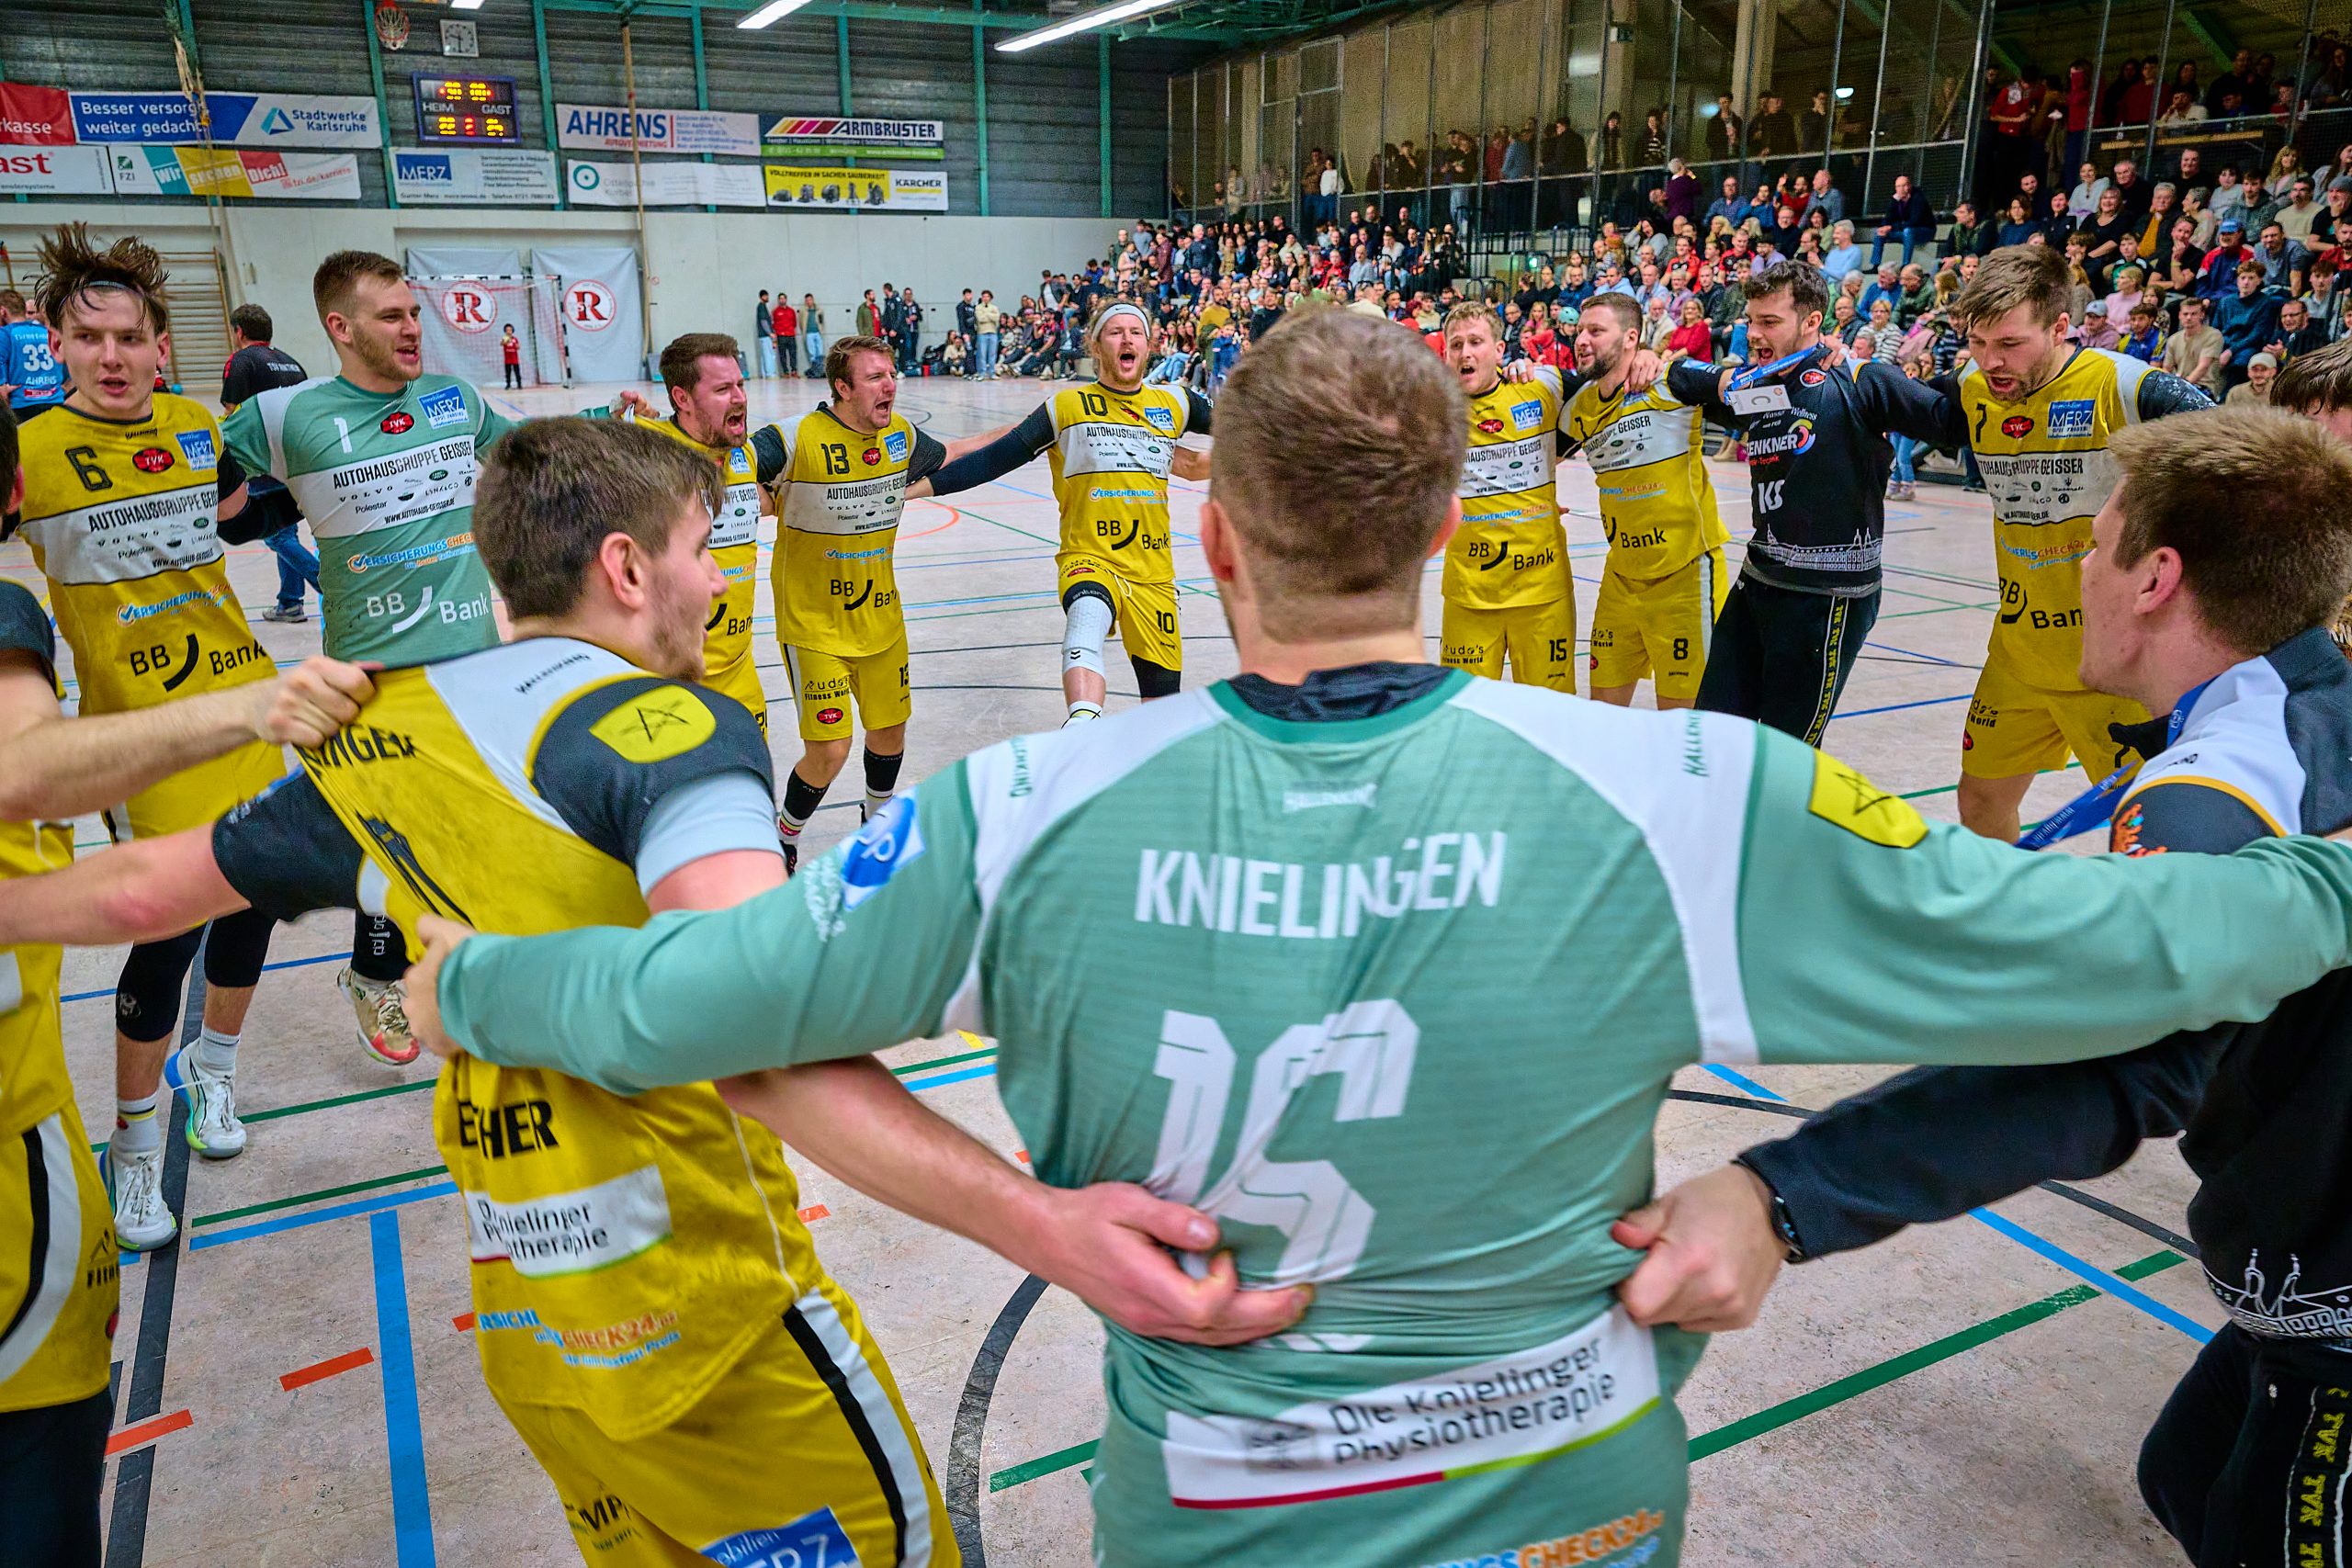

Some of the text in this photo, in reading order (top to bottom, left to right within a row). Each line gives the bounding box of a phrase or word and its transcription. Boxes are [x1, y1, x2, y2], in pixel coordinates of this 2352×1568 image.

[81, 101, 135, 115] Besser
[292, 109, 367, 122] Stadtwerke
[422, 102, 513, 116] HEIM GAST
[85, 119, 137, 134] weiter
[307, 120, 368, 132] Karlsruhe
[566, 109, 666, 139] AHRENS
[831, 120, 936, 138] ARMBRUSTER
[119, 172, 135, 181] FZI
[154, 166, 182, 184] Wir
[399, 165, 447, 181] MERZ
[22, 344, 55, 372] 33
[427, 396, 462, 419] MERZ
[1077, 390, 1109, 417] 10
[1617, 414, 1652, 434] GEISSER
[2050, 410, 2094, 428] MERZ
[334, 417, 353, 454] 1
[65, 446, 113, 491] 6
[333, 448, 439, 490] AUTOHAUSGRUPPE
[820, 443, 851, 476] 13
[2041, 458, 2084, 475] GEISSER
[827, 480, 892, 501] AUTOHAUSGRUPPE
[88, 492, 202, 533] AUTOHAUSGRUPPE
[355, 501, 389, 514] Polestar
[1096, 520, 1170, 550] BB Bank
[1620, 526, 1668, 549] Bank
[1468, 542, 1555, 570] BB Bank
[830, 580, 854, 597] BB
[367, 591, 490, 625] BB Bank
[2030, 608, 2084, 629] Ban
[727, 617, 753, 637] Ban
[1155, 610, 1175, 634] 10
[130, 637, 267, 677] BB Bank
[1549, 637, 1567, 662] 15
[1673, 637, 1690, 660] 8
[804, 693, 831, 701] Fitness
[1134, 830, 1508, 939] KNIELINGEN
[1329, 1336, 1602, 1438] Die Knielinger
[1333, 1369, 1618, 1465] Physiotherapie
[2299, 1412, 2346, 1568] TVK TVK TV
[717, 1531, 782, 1566] obilien
